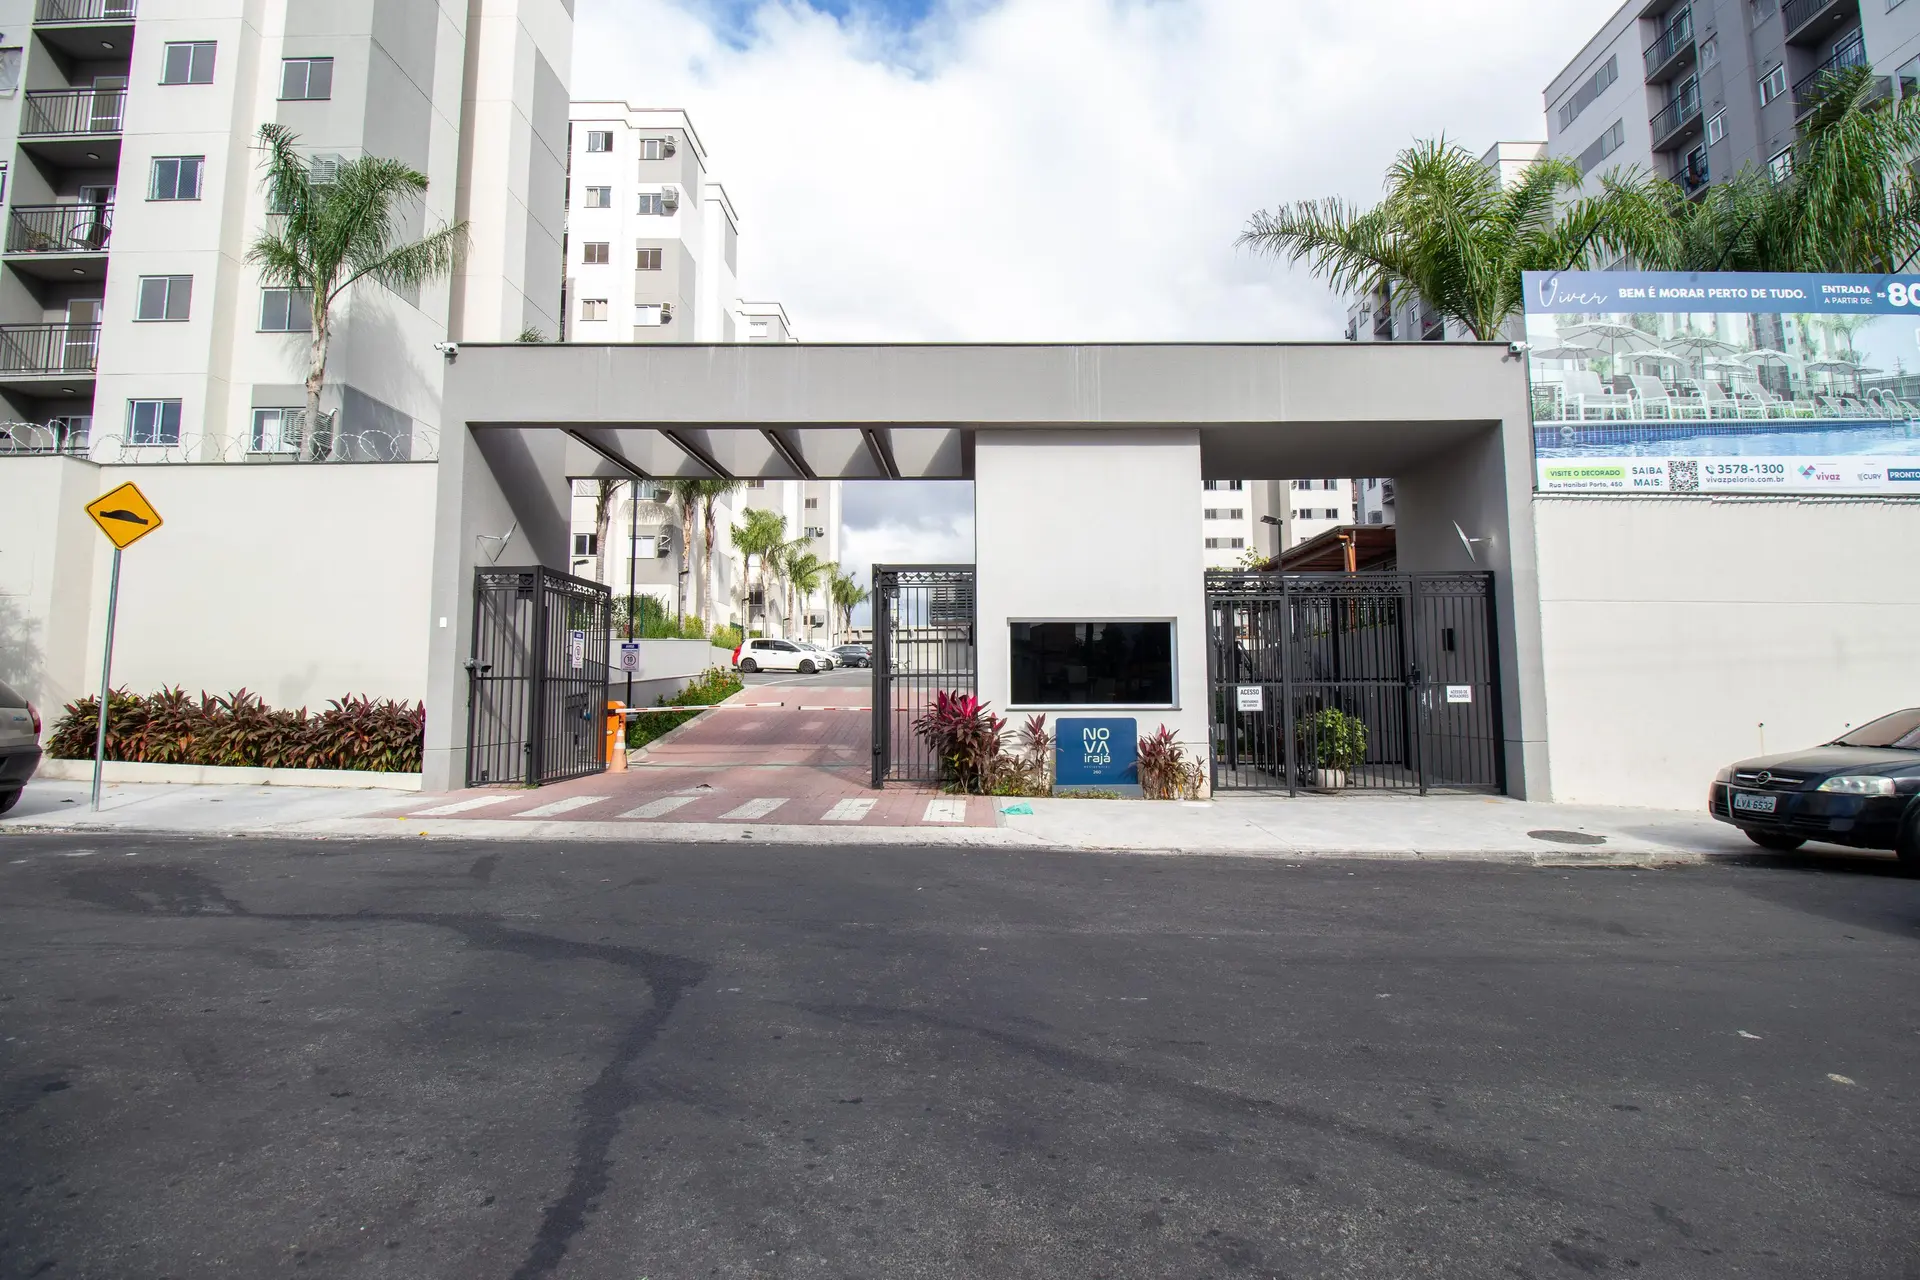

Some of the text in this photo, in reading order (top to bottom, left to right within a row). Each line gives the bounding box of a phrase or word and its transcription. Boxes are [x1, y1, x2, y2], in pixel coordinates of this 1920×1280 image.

[1538, 277, 1608, 307] Viver
[1618, 285, 1807, 299] BEM É MORAR PERTO DE TUDO.
[1821, 285, 1871, 294] ENTRADA
[1631, 466, 1663, 475] SAIBA
[1717, 464, 1784, 474] 3578-1300
[1705, 476, 1785, 484] vivazpelorio.com.br
[1816, 471, 1841, 481] vivaz
[1889, 471, 1920, 479] PRONTO
[1633, 478, 1663, 487] MAIS:
[1083, 728, 1110, 740] NO
[1084, 753, 1111, 765] irajá
